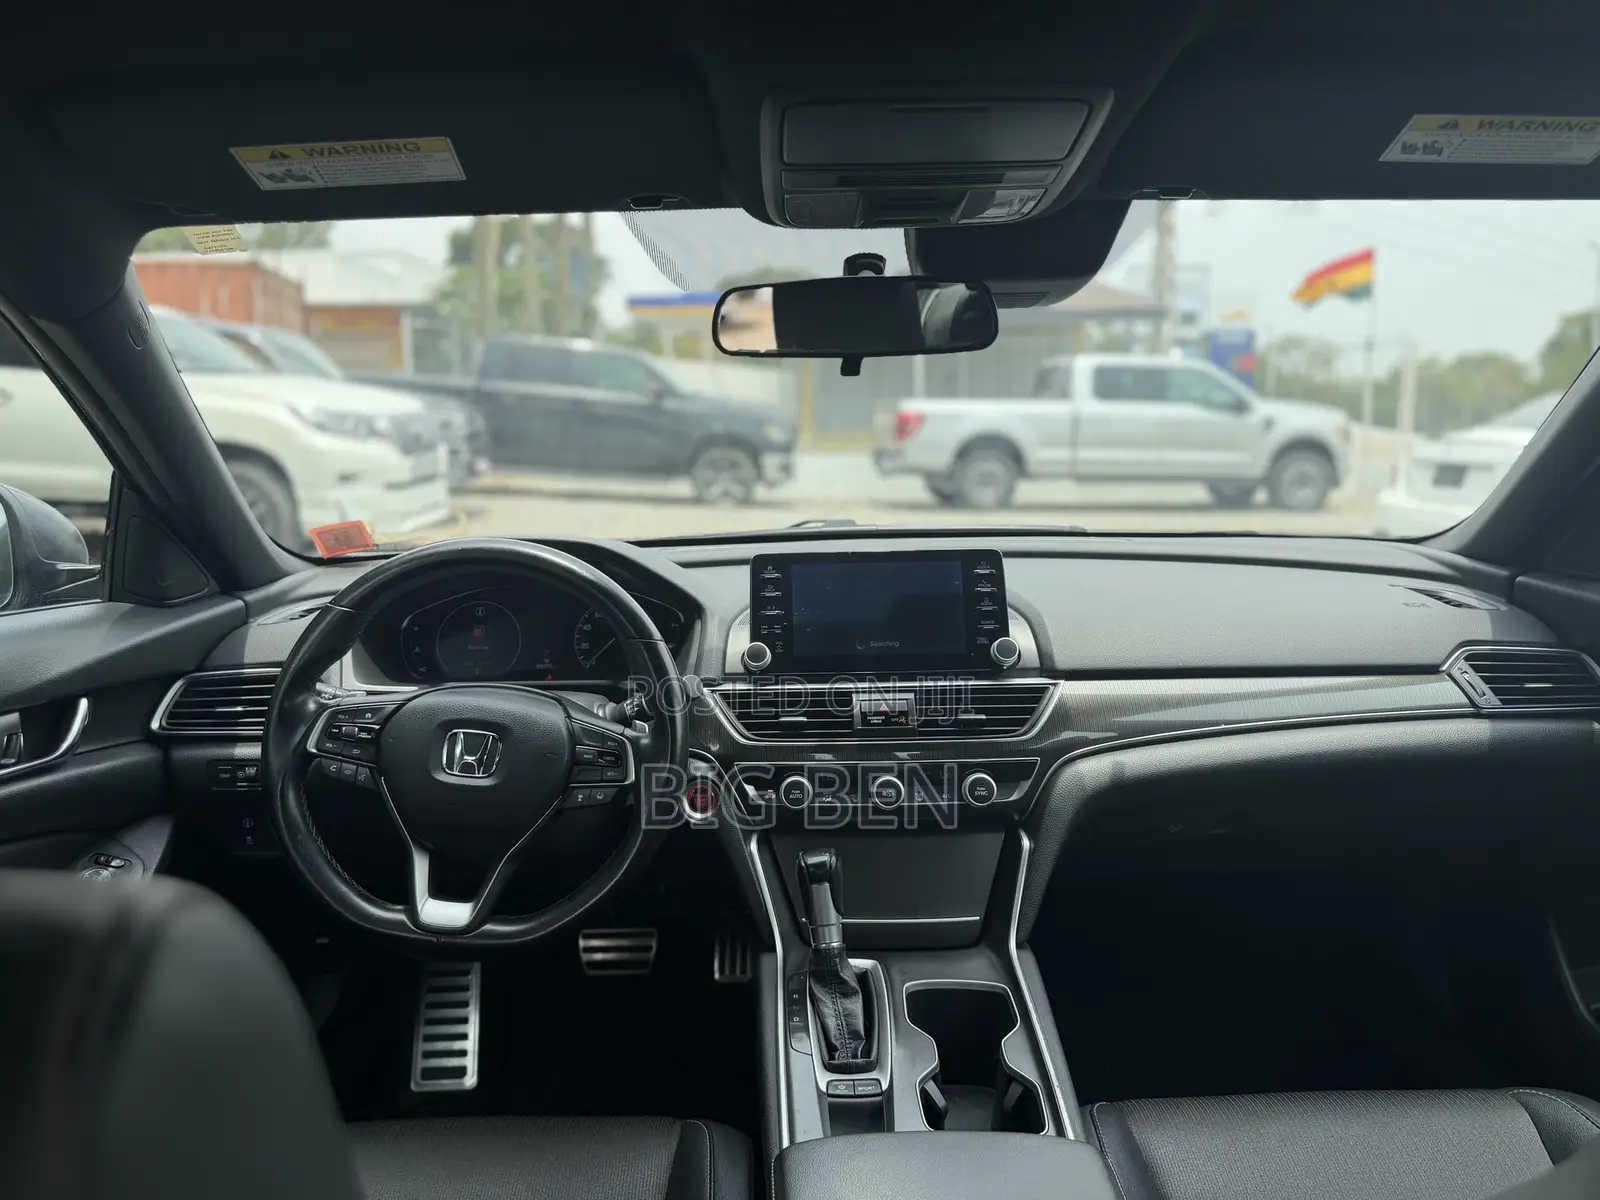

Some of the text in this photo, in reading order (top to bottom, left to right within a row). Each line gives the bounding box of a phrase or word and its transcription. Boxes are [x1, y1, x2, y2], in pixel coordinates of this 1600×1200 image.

[1476, 118, 1600, 132] WARNING
[301, 141, 421, 158] WARNING
[580, 642, 590, 650] 20
[869, 640, 901, 650] Searching
